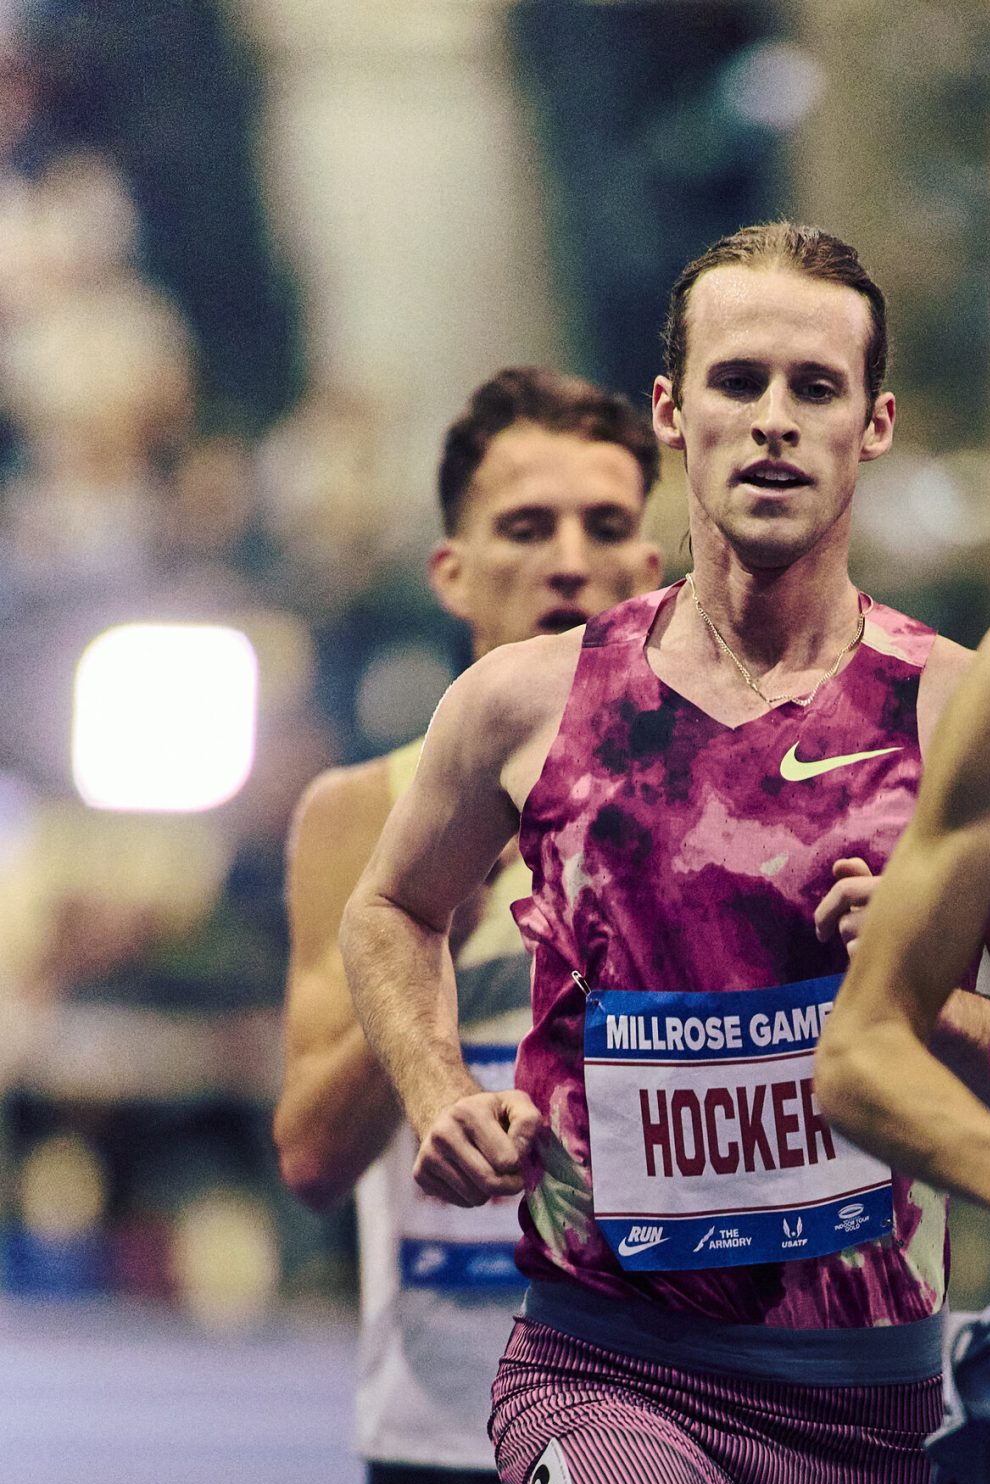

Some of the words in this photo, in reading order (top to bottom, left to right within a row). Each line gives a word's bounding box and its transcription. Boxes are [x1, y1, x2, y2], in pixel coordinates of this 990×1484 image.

[606, 1014, 743, 1051] MILLROSE
[749, 1001, 834, 1047] GAM
[639, 1078, 837, 1177] HOCKER
[627, 1226, 664, 1243] RUN
[719, 1228, 740, 1239] THE
[708, 1237, 753, 1250] ARMORY
[781, 1238, 808, 1248] USATF
